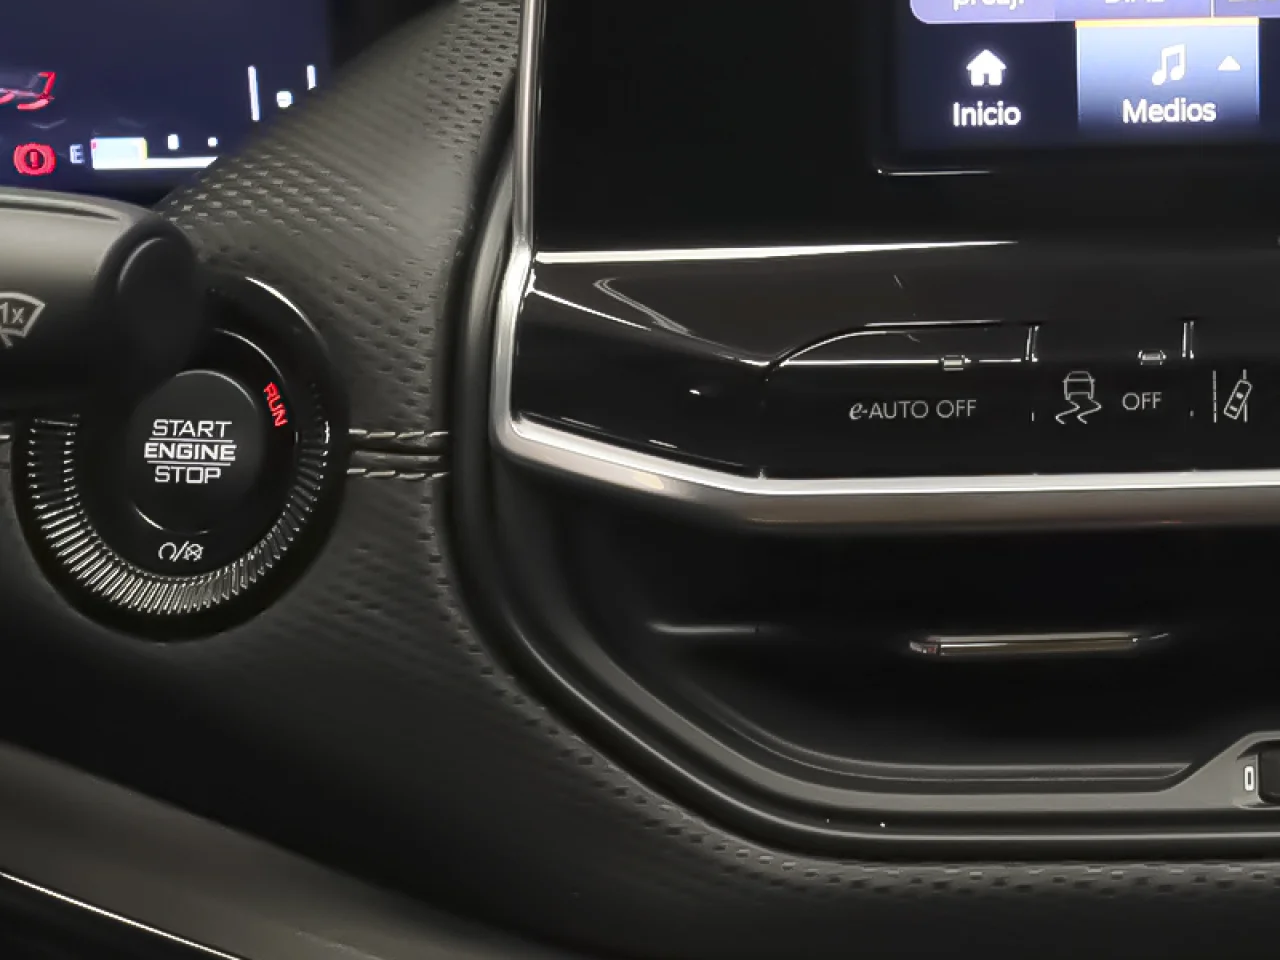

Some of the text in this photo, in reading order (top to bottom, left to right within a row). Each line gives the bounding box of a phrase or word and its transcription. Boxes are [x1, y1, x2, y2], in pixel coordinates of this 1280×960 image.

[953, 101, 1022, 126] Inicio
[1122, 98, 1217, 123] Medios
[70, 144, 84, 164] E
[263, 382, 287, 427] RUN
[936, 400, 977, 418] OFF
[1122, 393, 1162, 411] OFF
[152, 419, 233, 438] START
[143, 442, 237, 462] ENGINE
[154, 465, 222, 484] STOP
